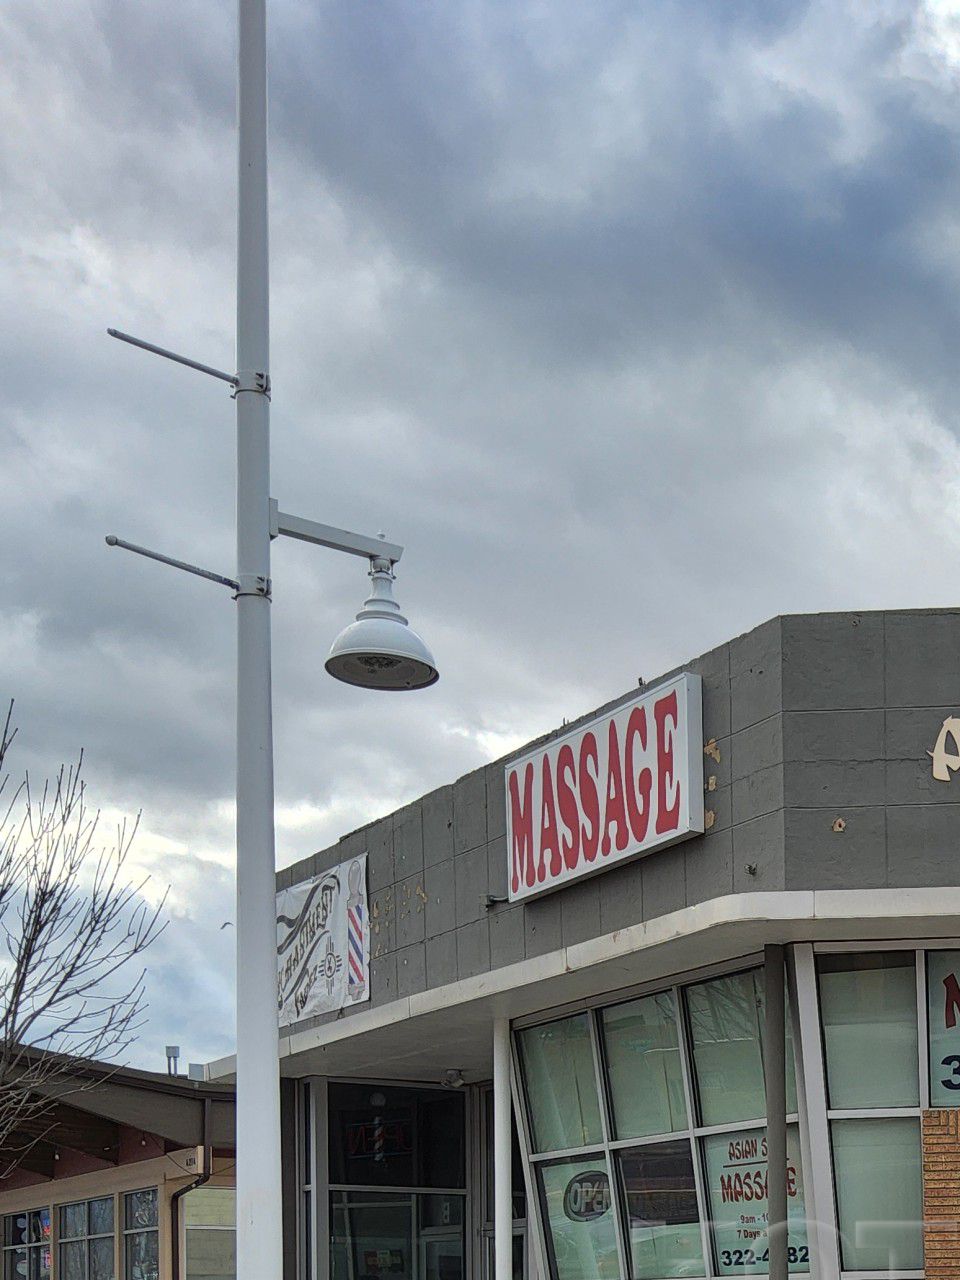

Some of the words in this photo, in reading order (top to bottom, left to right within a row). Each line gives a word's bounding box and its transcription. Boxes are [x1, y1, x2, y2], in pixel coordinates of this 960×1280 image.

[508, 689, 681, 893] MASSAGE
[728, 1138, 758, 1160] ASIAN
[720, 1166, 798, 1204] MASSE
[743, 1229, 761, 1240] Days
[721, 1246, 809, 1266] 322-482
